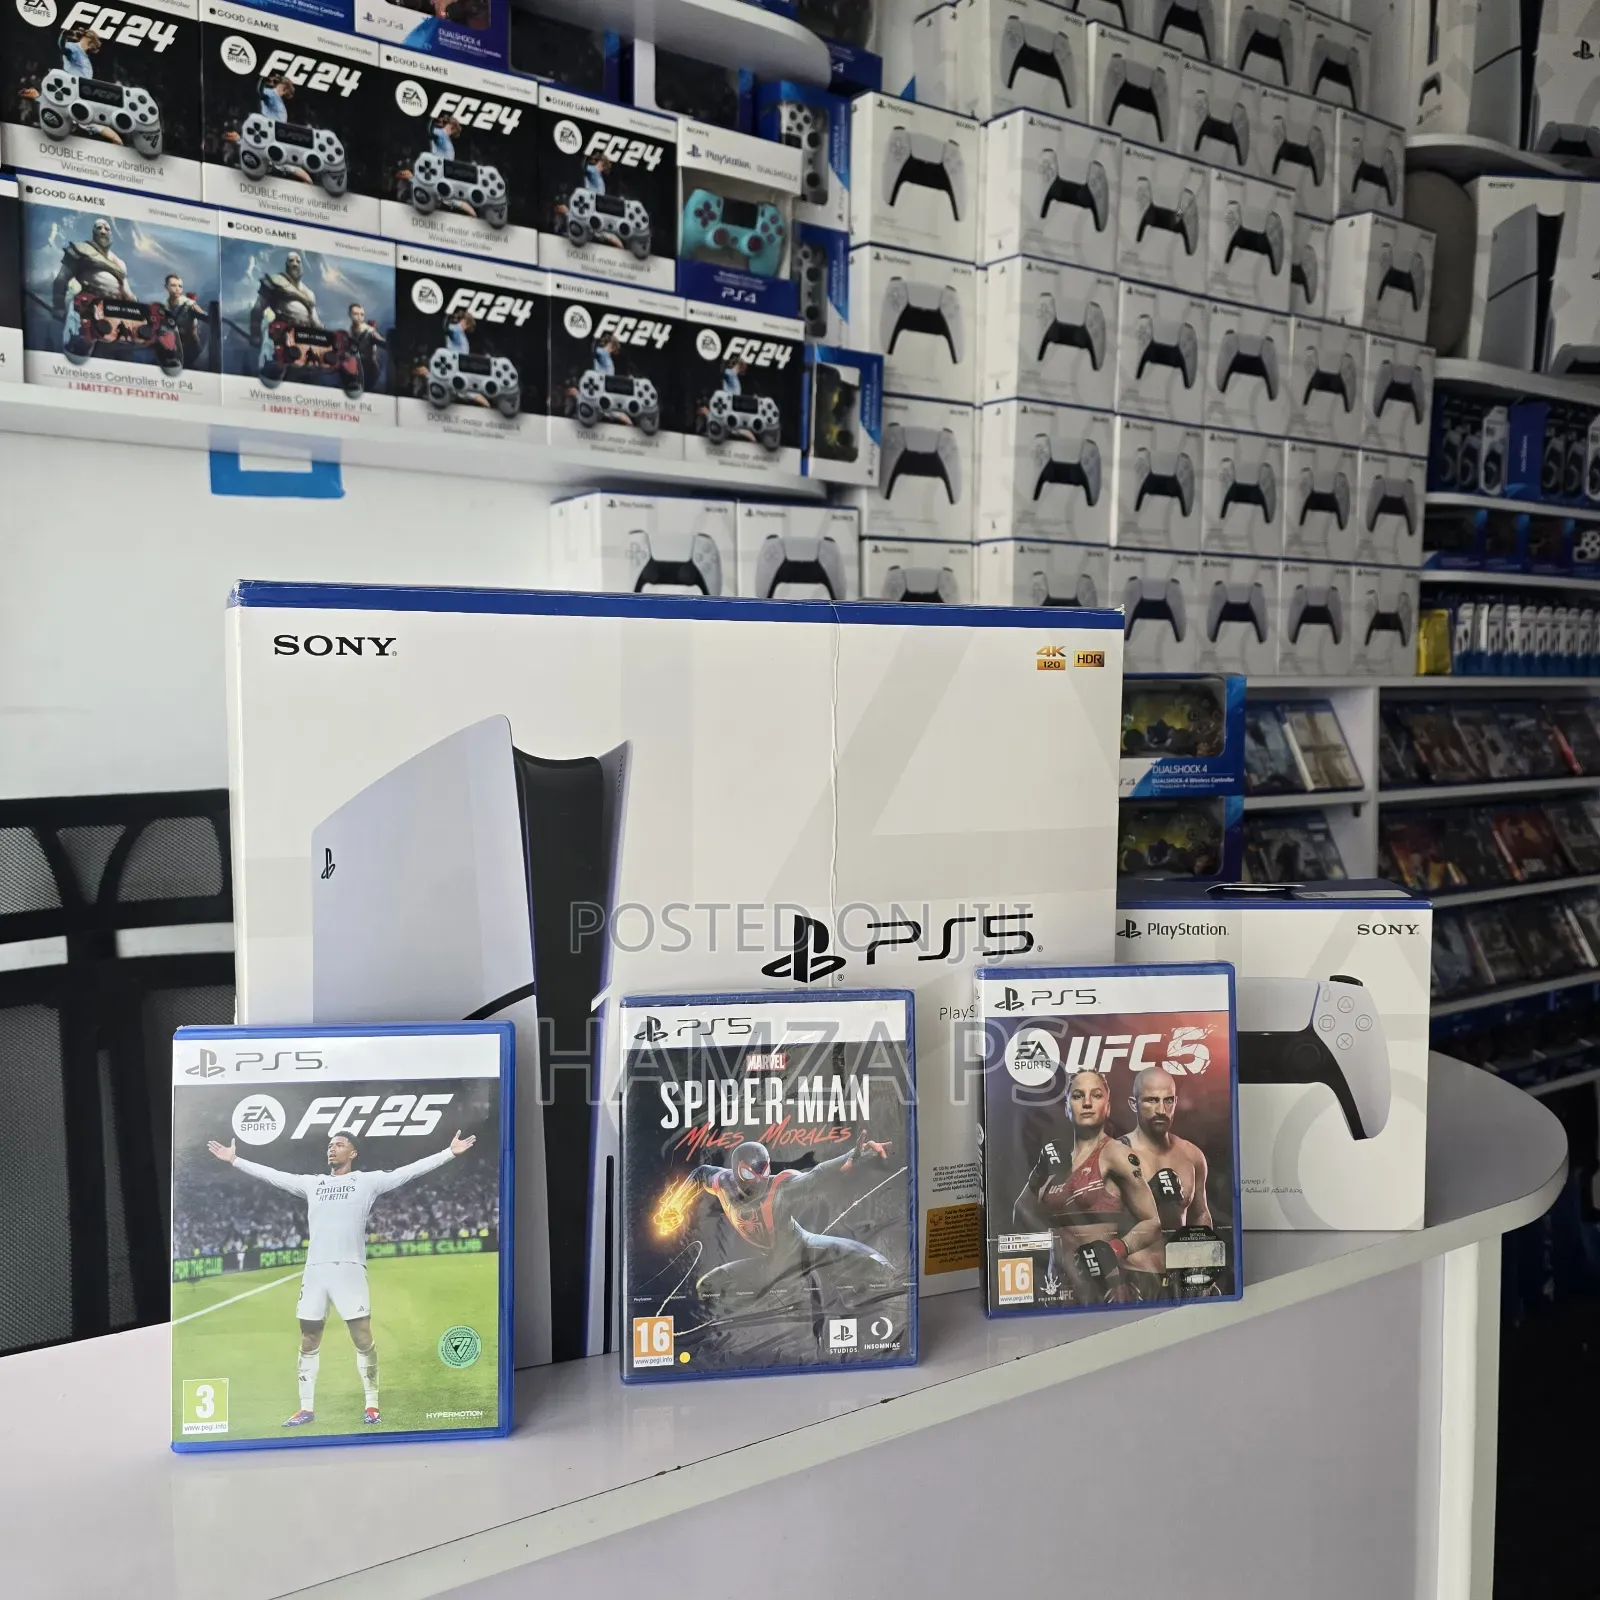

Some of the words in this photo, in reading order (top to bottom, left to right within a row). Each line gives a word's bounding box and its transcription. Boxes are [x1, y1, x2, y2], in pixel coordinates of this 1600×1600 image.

[23, 5, 52, 18] SPORTS
[217, 9, 246, 24] GOOD
[246, 17, 280, 33] GAMES
[60, 1, 179, 53] FC24
[226, 55, 252, 66] SPORTS
[228, 43, 250, 60] EA
[259, 49, 362, 98] FC24
[419, 61, 450, 77] GAMES
[402, 87, 422, 101] EA
[430, 91, 523, 136] FC24
[39, 142, 115, 168] DOUBLE-motor
[117, 160, 156, 176] vibration
[157, 167, 165, 177] 4
[584, 131, 664, 172] FC24
[60, 160, 101, 178] Wireless
[101, 168, 145, 185] Controller
[35, 186, 67, 201] GOOD
[68, 191, 106, 207] GAMES
[306, 197, 342, 212] vibration
[258, 199, 293, 215] Wireless
[293, 207, 331, 222] Controller
[265, 227, 298, 241] GAMES
[721, 286, 757, 304] PS4
[445, 287, 534, 327] FC24
[593, 313, 673, 349] FC24
[722, 336, 793, 370] FC24
[52, 364, 102, 380] Wireless
[105, 371, 159, 388] Controller
[161, 378, 177, 389] for
[178, 379, 195, 391] P4
[250, 388, 293, 404] Wireless
[295, 394, 342, 410] Controller
[344, 400, 358, 411] for
[273, 634, 397, 657] SONY
[1036, 645, 1067, 658] 4K
[1043, 661, 1061, 669] 120
[1077, 654, 1102, 664] HDR
[1152, 764, 1200, 774] DUALSHOCK
[1202, 764, 1208, 773] 4
[866, 912, 1036, 967] PS5
[1147, 922, 1230, 940] PlayStation
[1357, 924, 1419, 936] SONY
[1031, 988, 1098, 1006] PS5
[676, 1017, 753, 1036] PS5
[1016, 1040, 1050, 1060] EA
[1065, 1034, 1162, 1074] UFC
[1162, 1024, 1218, 1076] 5
[235, 1050, 324, 1072] PS5
[747, 1054, 786, 1071] MARVEL
[1014, 1060, 1051, 1070] SPORTS
[660, 1074, 871, 1130] SPIDER-MAN
[242, 1105, 277, 1123] EA
[290, 1093, 455, 1141] FC25
[240, 1122, 278, 1133] SPORTS
[673, 1121, 745, 1162] MILES
[757, 1114, 852, 1150] MORALES
[1044, 1142, 1061, 1165] UFC
[315, 1183, 357, 1196] Emirates
[1158, 1170, 1176, 1196] UFC
[319, 1193, 329, 1202] FLY
[328, 1192, 350, 1202] BETTER
[401, 1241, 433, 1255] THE
[436, 1238, 482, 1254] CLUB
[1083, 1248, 1101, 1277] UFC
[1001, 1263, 1030, 1292] 16
[1000, 1294, 1033, 1303] www.pegi.info
[635, 1321, 671, 1354] 16
[864, 1342, 900, 1351] INSOMNIAC
[829, 1347, 858, 1355] STUDIOS
[634, 1356, 673, 1366] www.pegi.info
[195, 1384, 215, 1419] 3
[426, 1410, 483, 1419] HYPERMOTION
[184, 1422, 228, 1432] www.pegi.info
